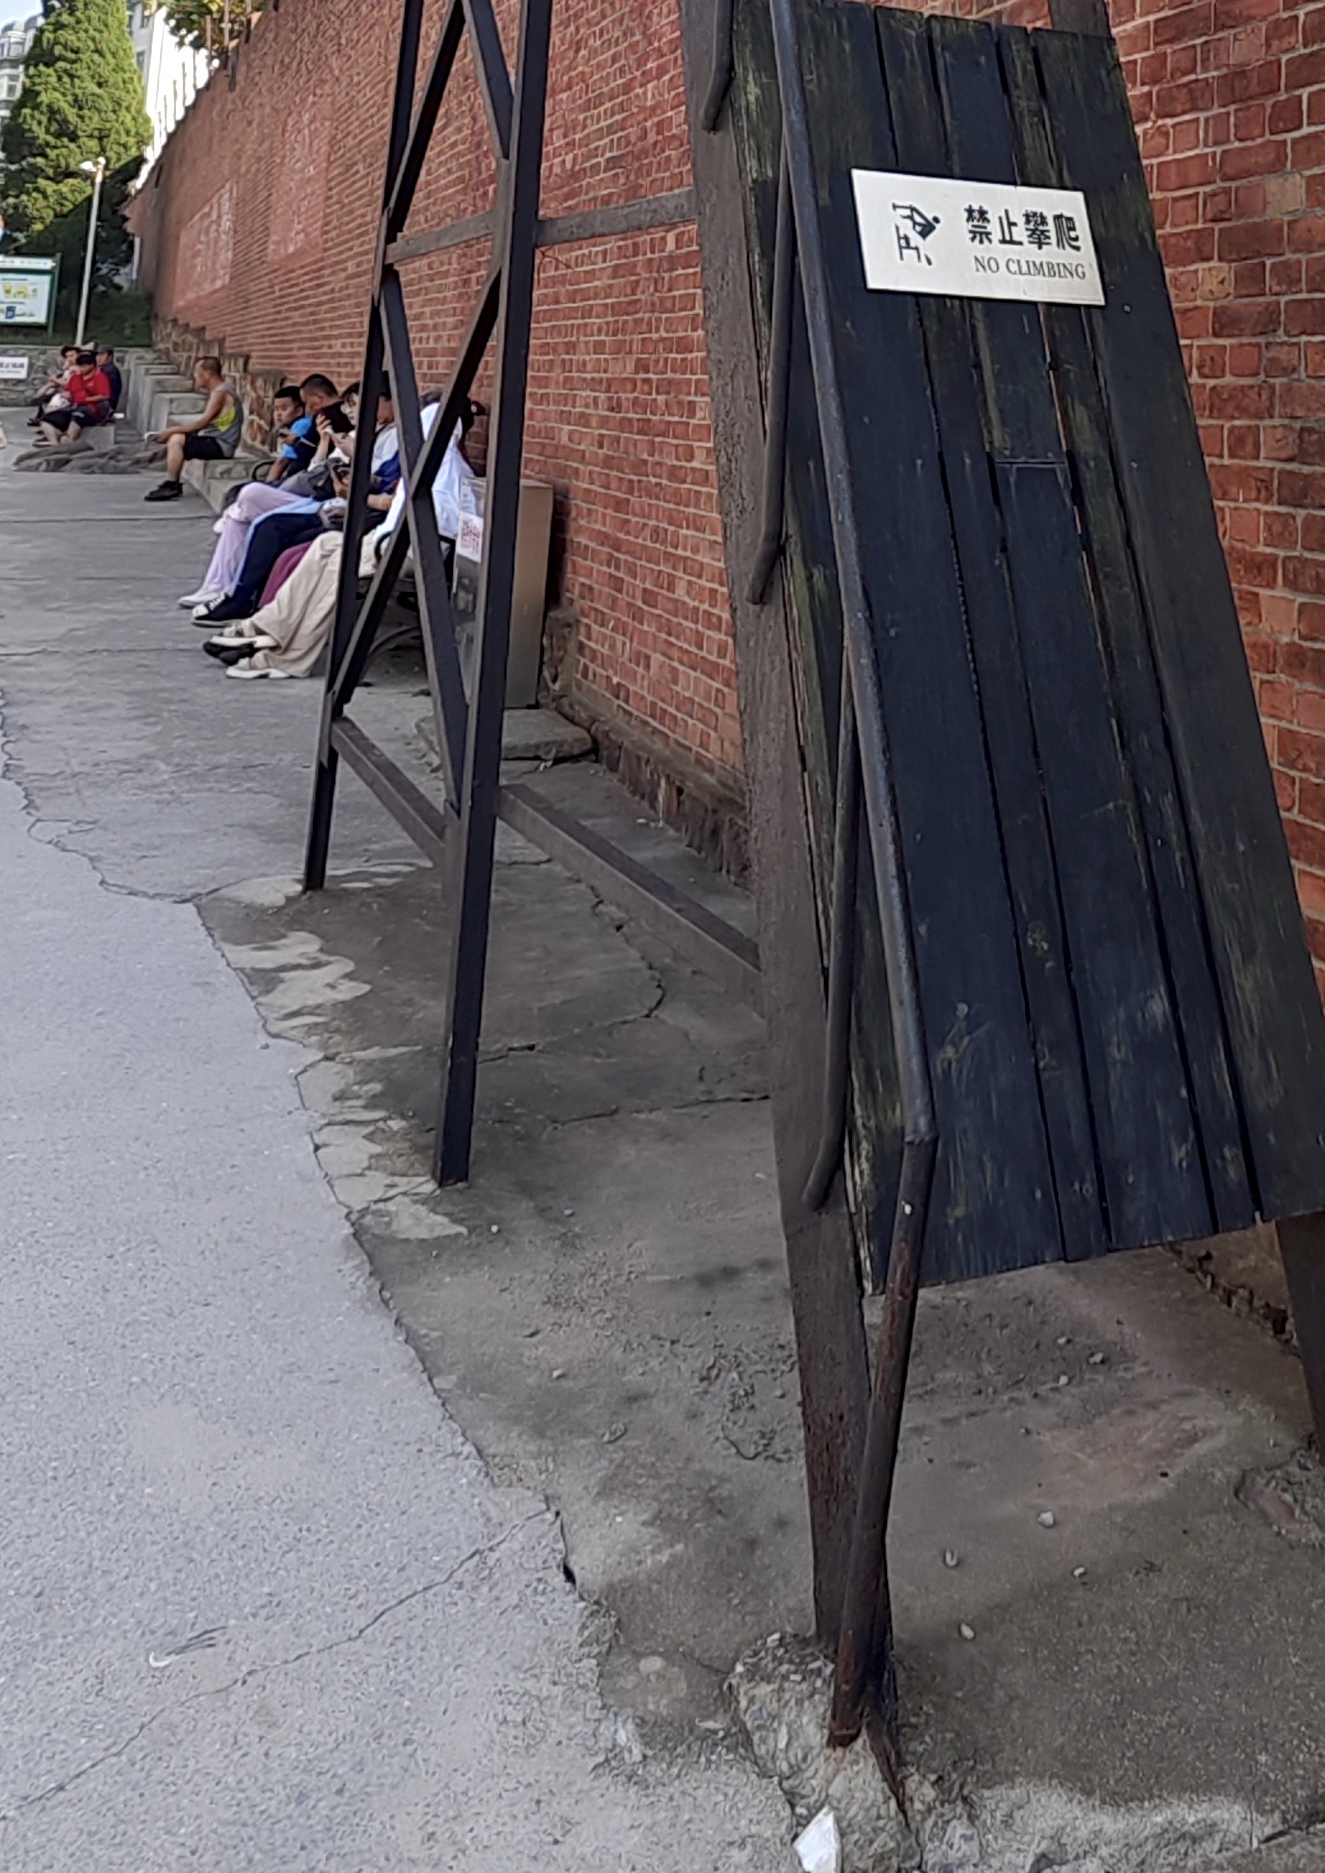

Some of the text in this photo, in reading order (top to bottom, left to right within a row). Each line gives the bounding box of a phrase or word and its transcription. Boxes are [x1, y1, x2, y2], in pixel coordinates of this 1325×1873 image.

[964, 204, 1081, 252] 禁止攀爬
[973, 255, 1086, 280] NO CLIMBING
